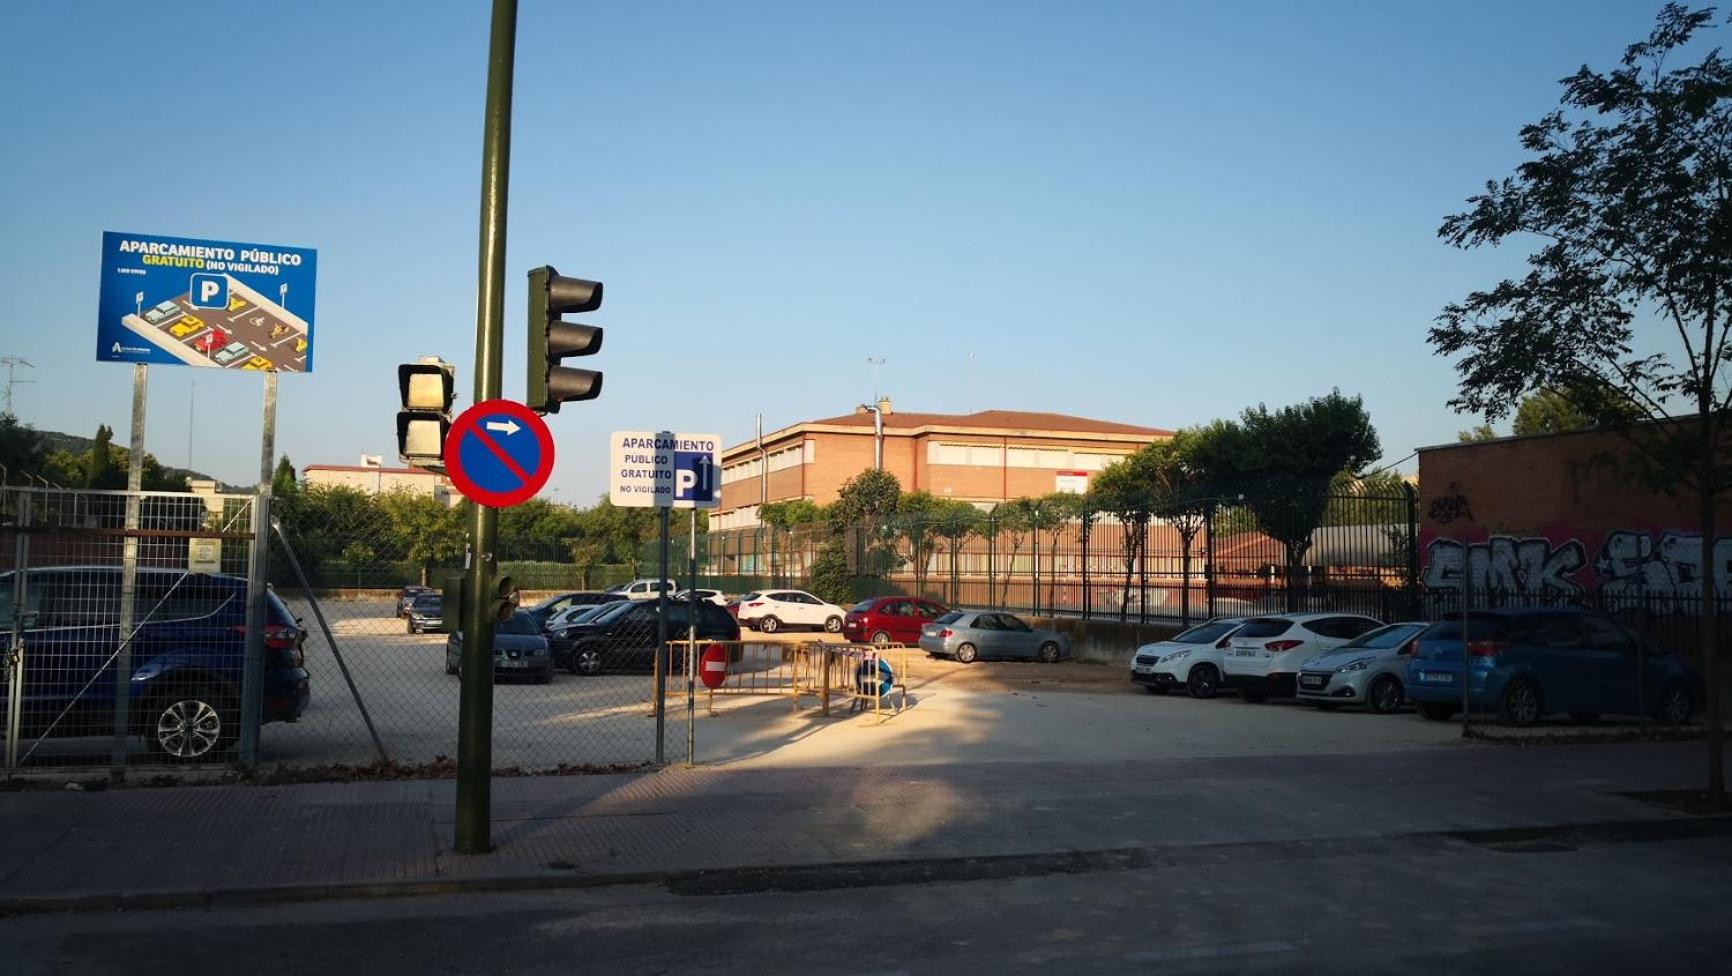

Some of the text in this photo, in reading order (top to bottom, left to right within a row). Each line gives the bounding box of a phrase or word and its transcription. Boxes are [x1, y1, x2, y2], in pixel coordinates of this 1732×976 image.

[119, 240, 302, 266] APARCAMIENTO PÚBLICO
[142, 254, 279, 276] GRATUITO (NO VIGILADO)
[201, 280, 220, 303] P
[622, 438, 714, 451] APARCAMIENTO
[620, 469, 672, 479] GRATUITO
[675, 469, 698, 498] P
[634, 486, 671, 494] VIGILADO
